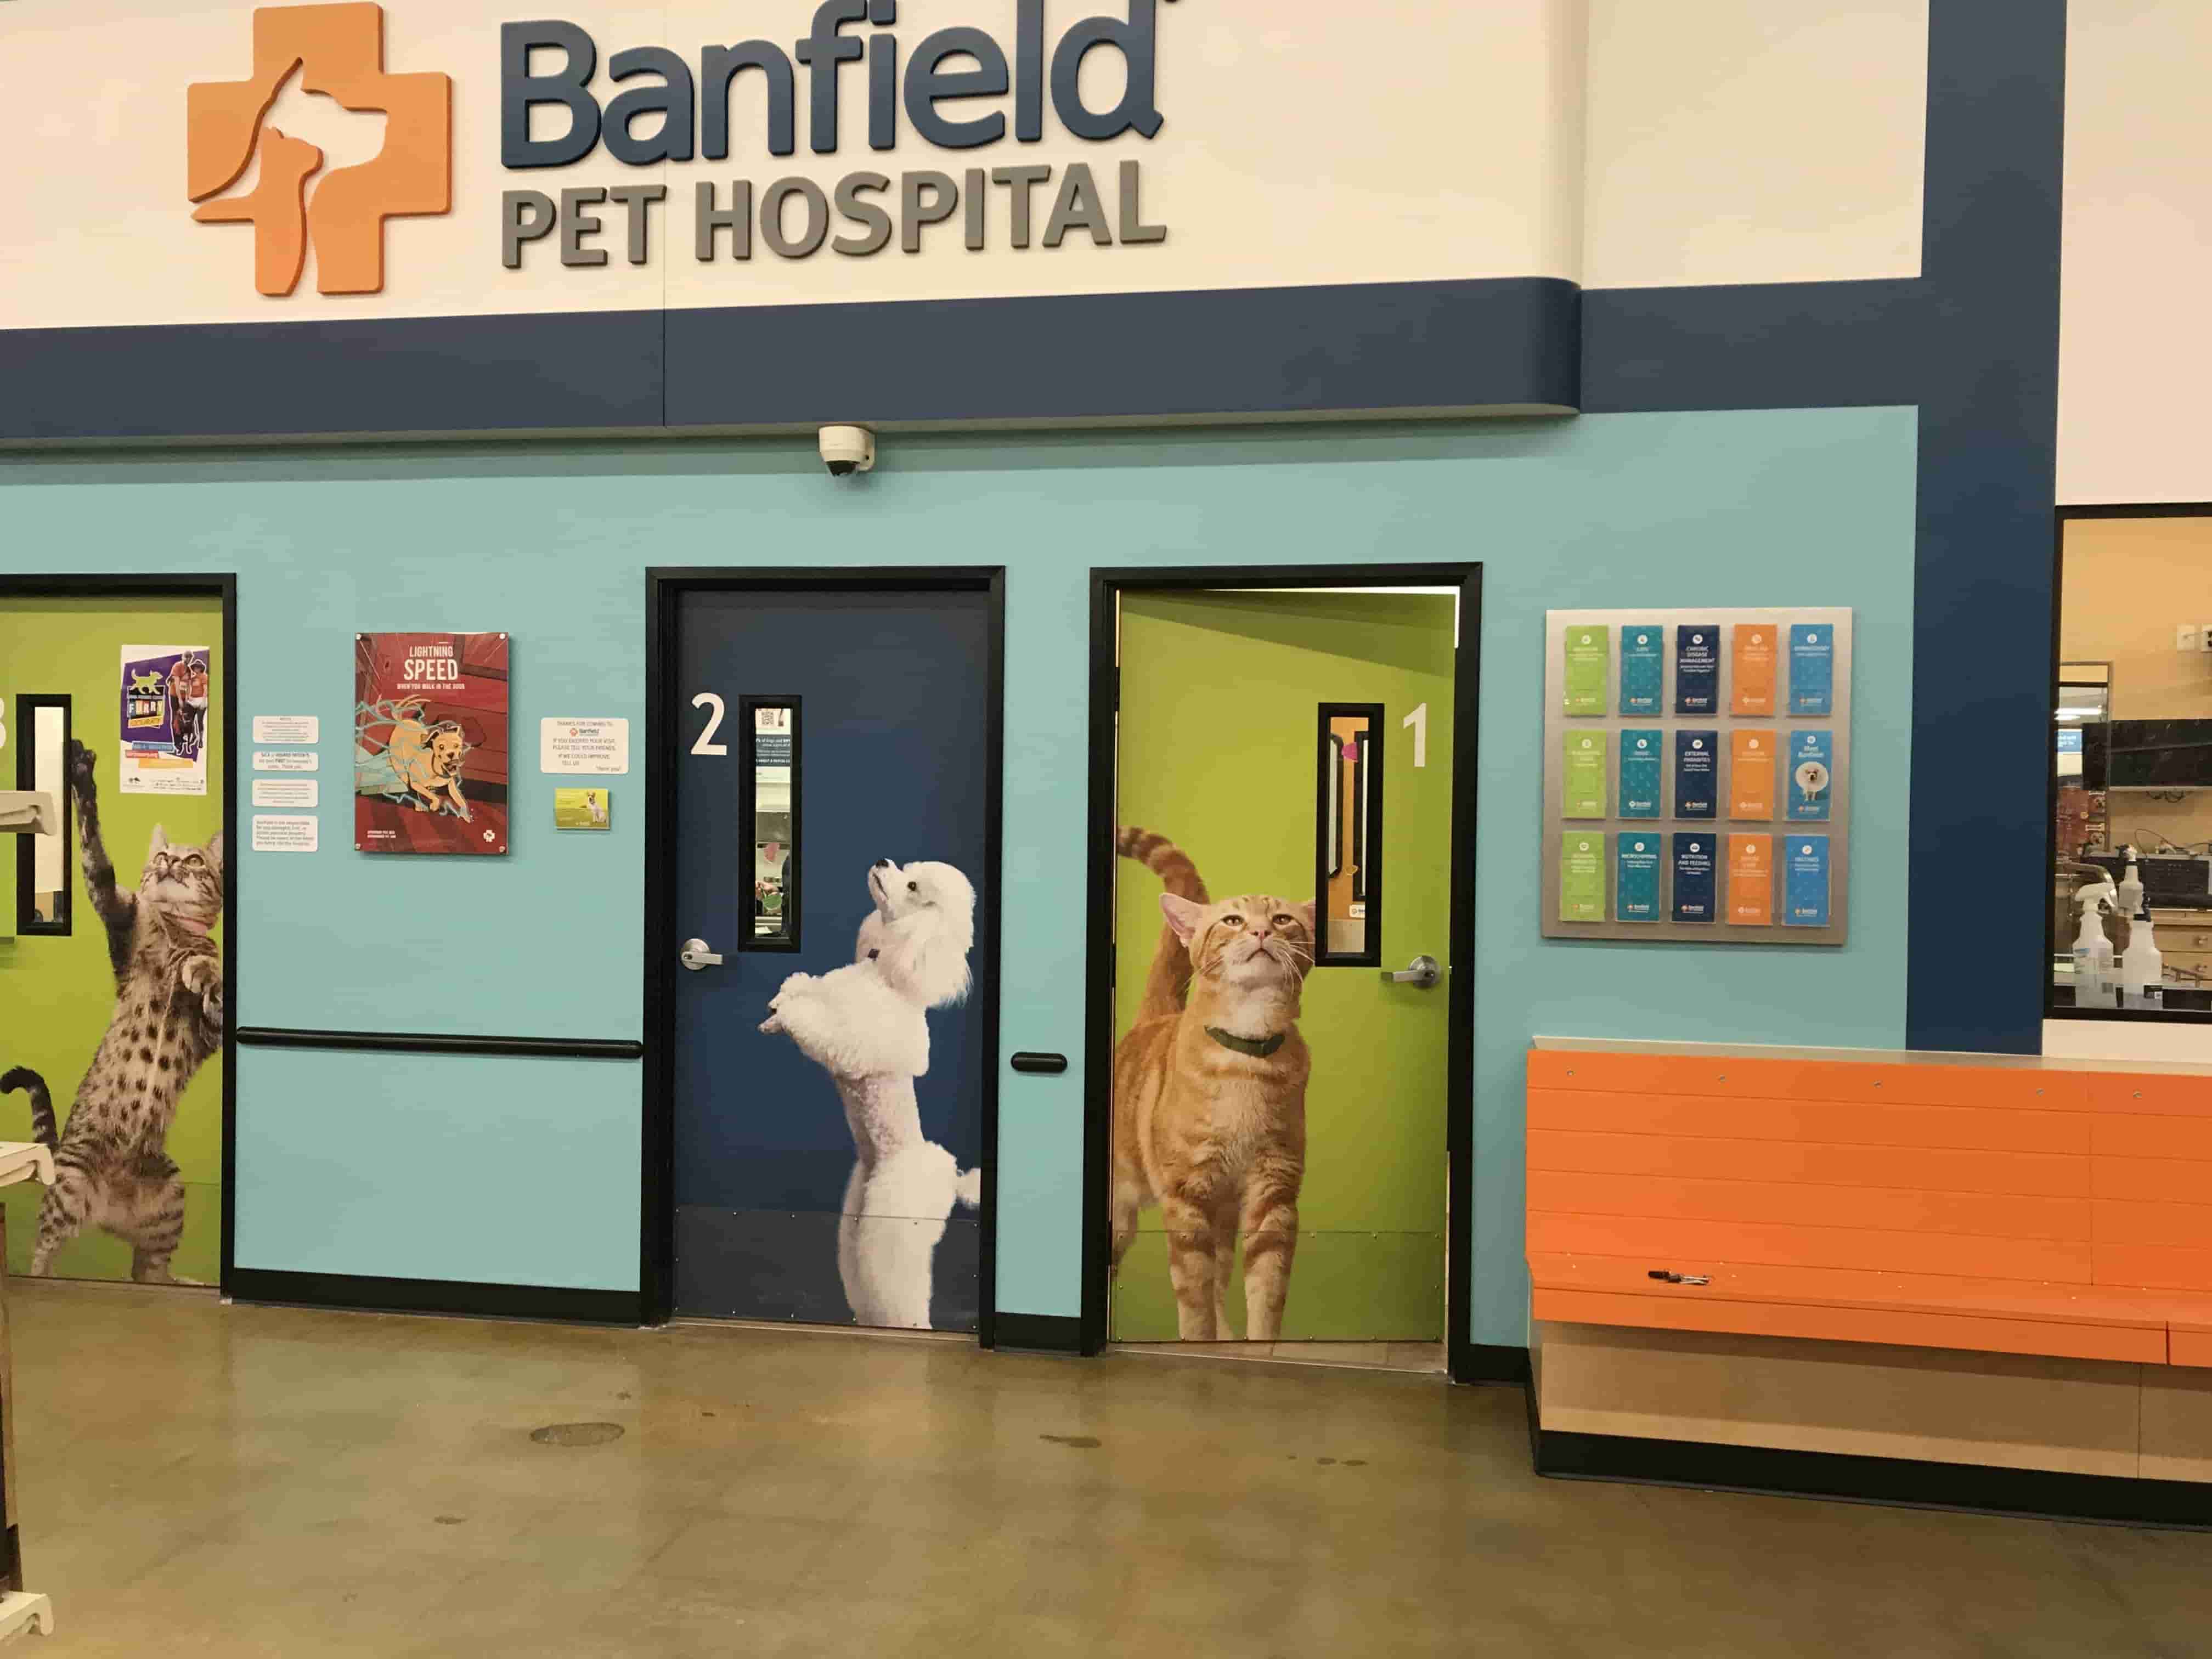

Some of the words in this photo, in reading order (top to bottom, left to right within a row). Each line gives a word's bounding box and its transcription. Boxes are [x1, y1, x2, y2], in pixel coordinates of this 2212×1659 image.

[501, 0, 1164, 169] Banfield
[502, 184, 667, 269] PET
[695, 159, 1167, 260] HOSPITAL
[403, 659, 458, 681] SPEED
[409, 645, 453, 657] LIGHTNING
[129, 700, 163, 713] FURRY
[691, 692, 727, 755] 2
[1403, 702, 1427, 768] 1
